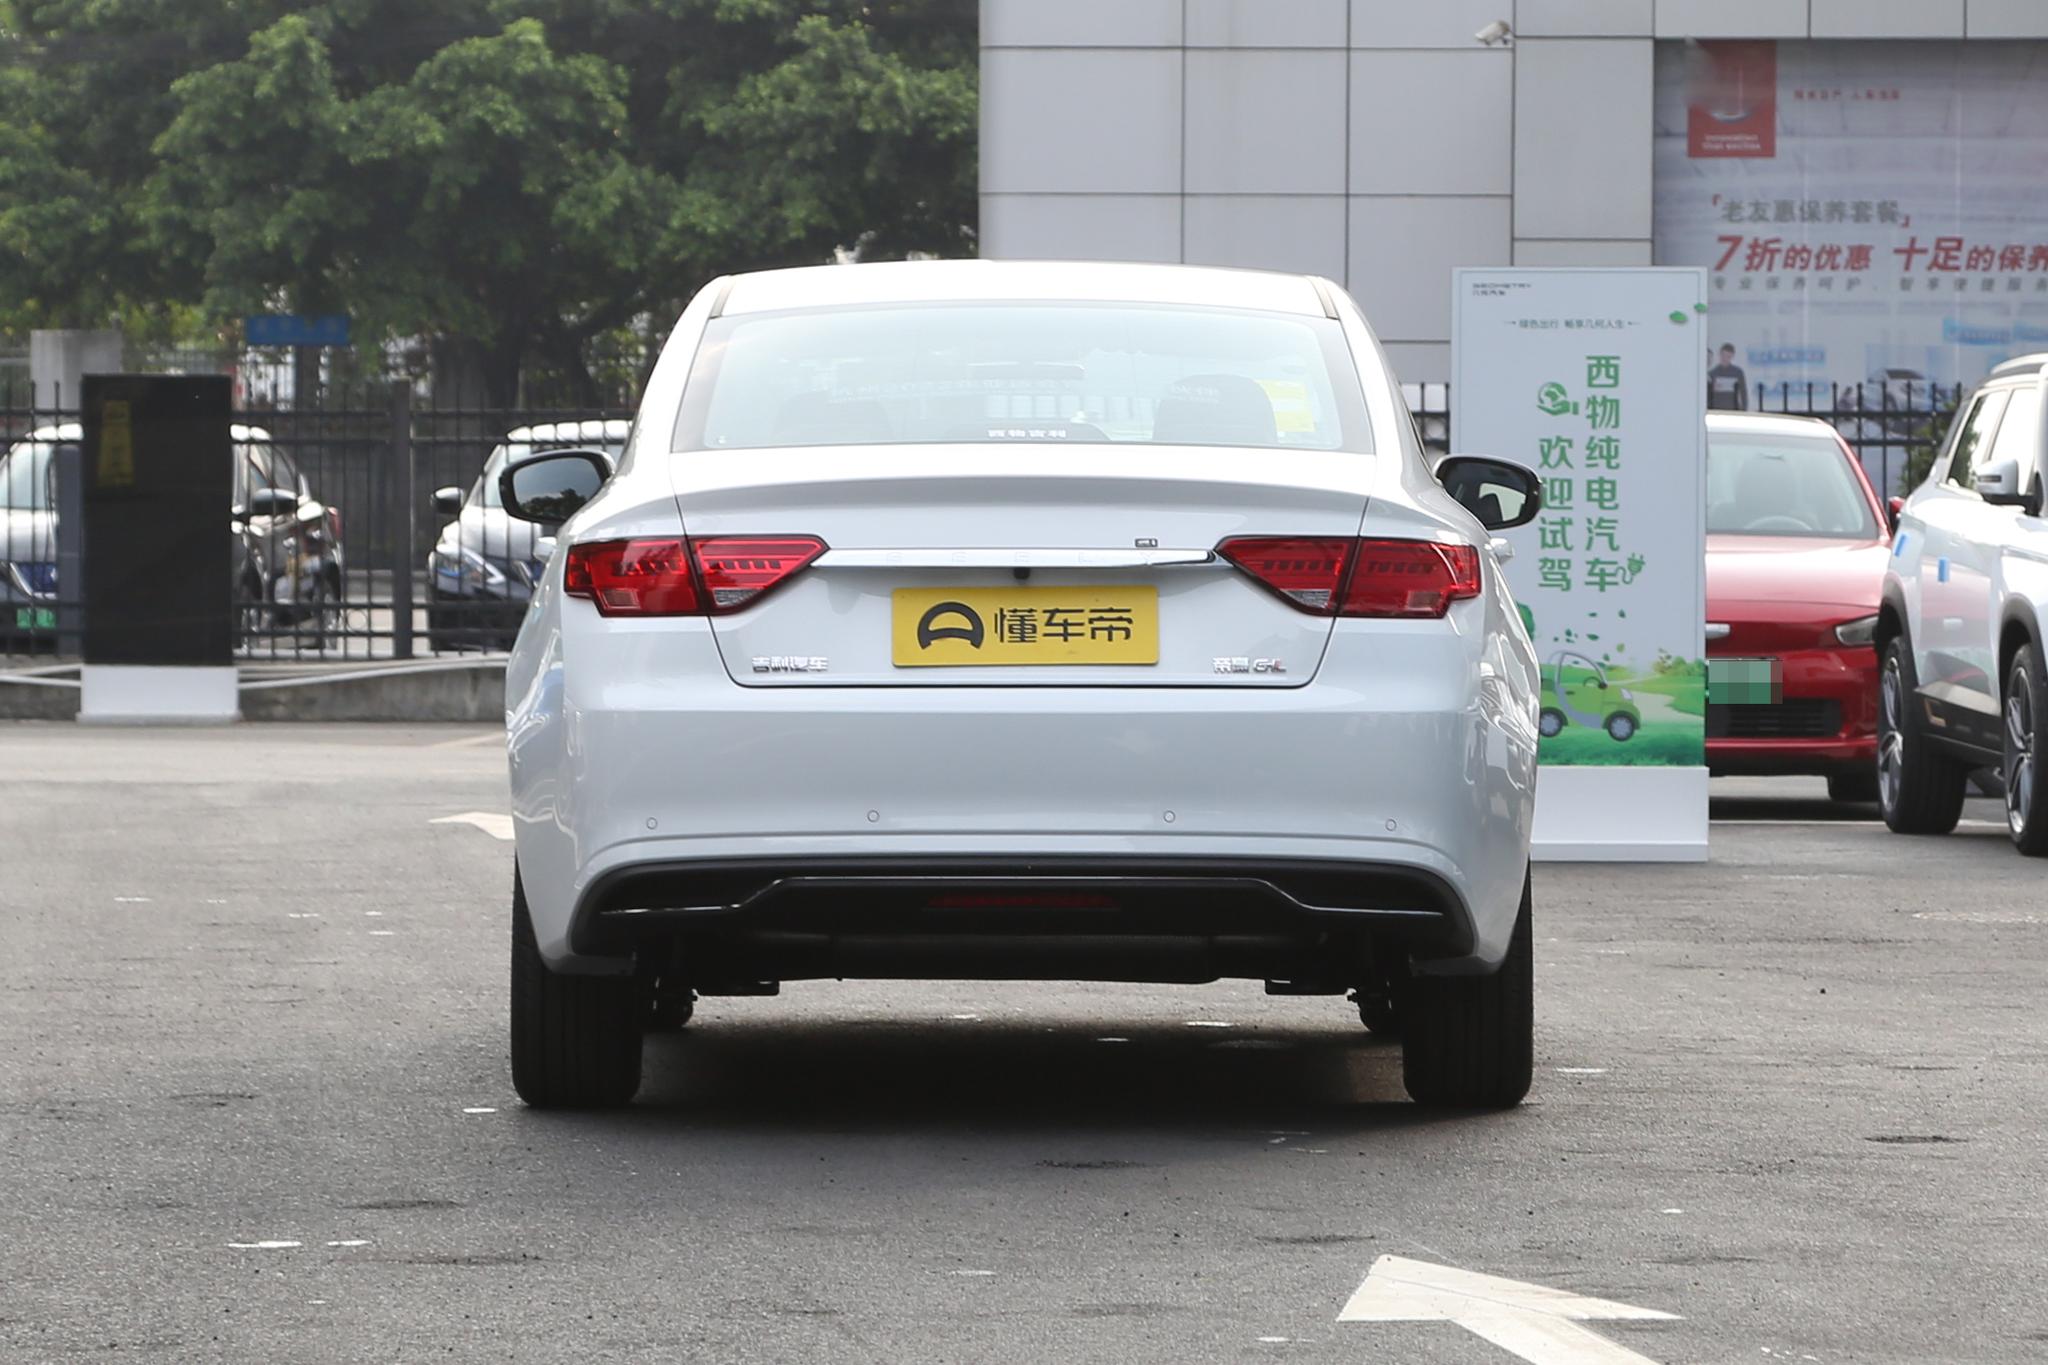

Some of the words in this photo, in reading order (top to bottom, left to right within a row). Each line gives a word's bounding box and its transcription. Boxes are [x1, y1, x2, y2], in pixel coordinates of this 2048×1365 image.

[1714, 235, 1874, 273] 7折的优惠
[1538, 435, 1574, 592] 欢迎试驾
[1584, 355, 1621, 593] 西物纯电汽车
[994, 607, 1133, 643] 懂车帝
